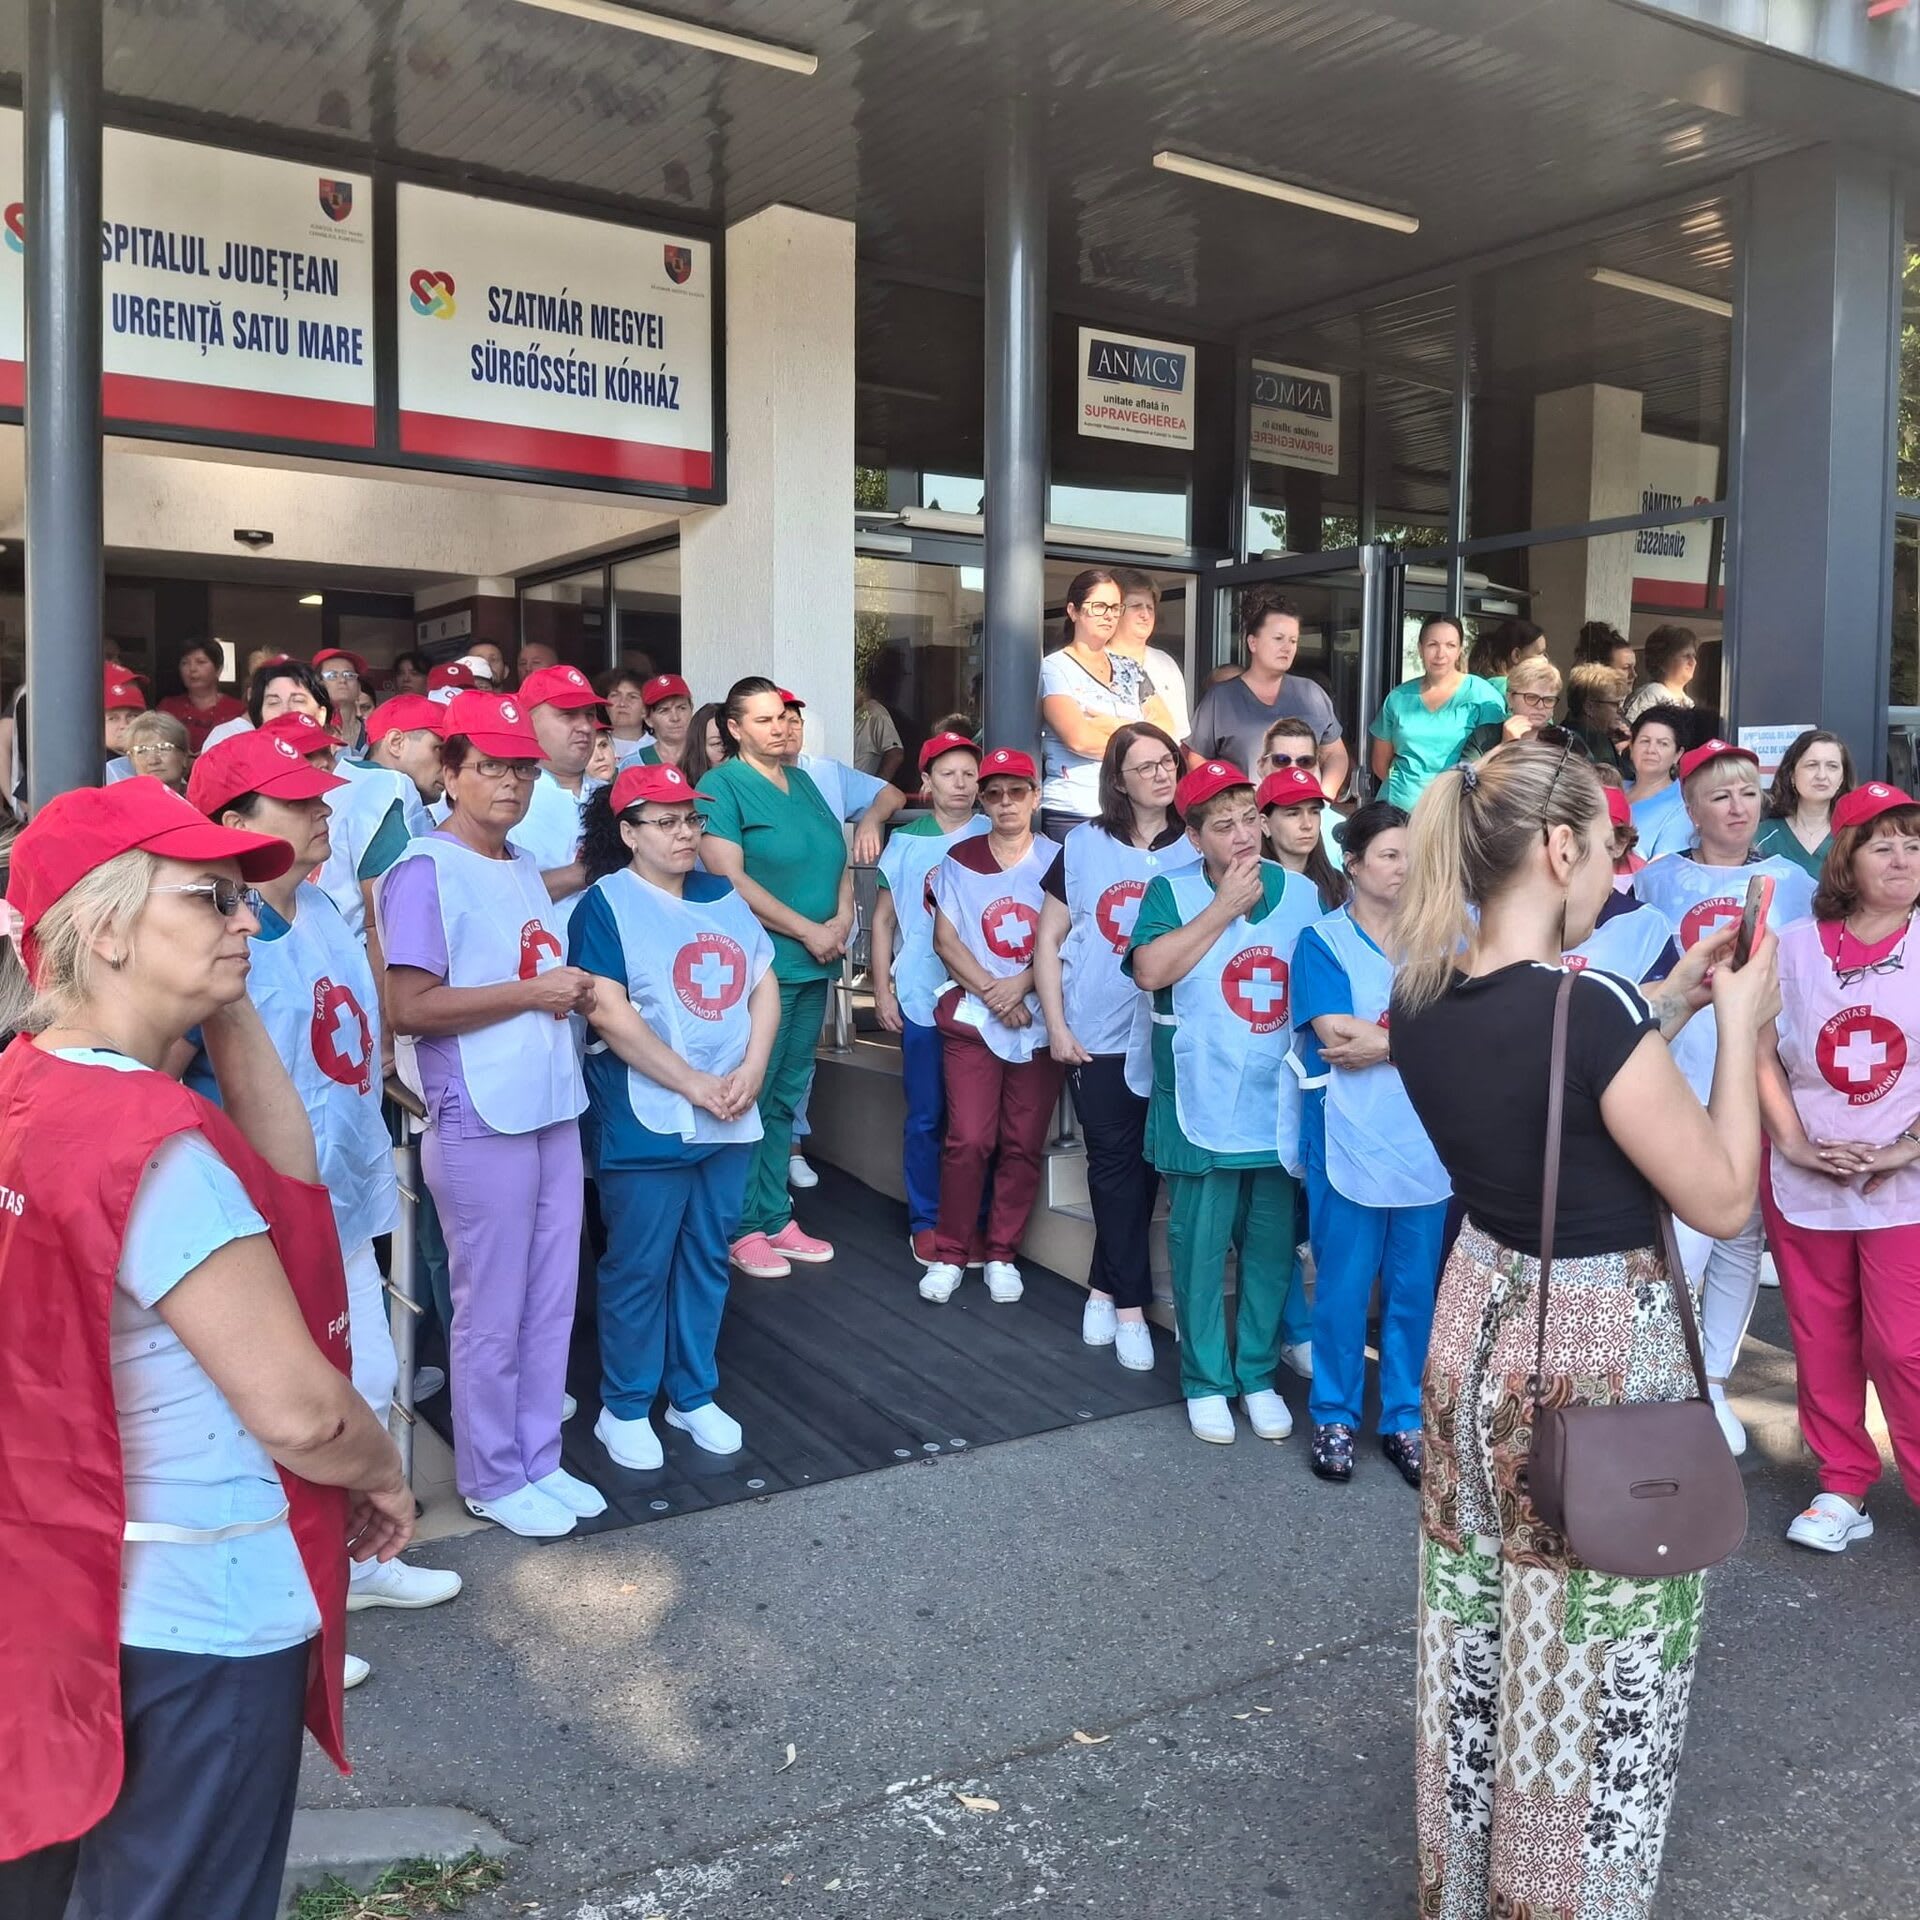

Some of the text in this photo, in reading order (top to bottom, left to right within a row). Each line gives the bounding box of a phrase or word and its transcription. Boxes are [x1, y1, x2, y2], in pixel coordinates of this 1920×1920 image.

[102, 221, 339, 300] SPITALUL JUDEȚEAN
[112, 292, 363, 366] URGENȚĂ SATU MARE
[488, 287, 664, 350] SZATMÁR MEGYEI
[471, 339, 680, 411] SÜRGŐSSÉGI KÓRHÁZ
[1097, 347, 1178, 385] ANMCS
[1103, 394, 1133, 407] unitate
[1084, 403, 1187, 431] SUPRAVEGHEREA
[1108, 881, 1142, 895] SANITAS
[984, 898, 1011, 920] SANITAS
[1692, 898, 1733, 916] SANITAS
[1232, 947, 1269, 968] SANITAS
[1825, 1007, 1867, 1035] SANITAS
[1854, 1069, 1899, 1103] ROMÂNIA
